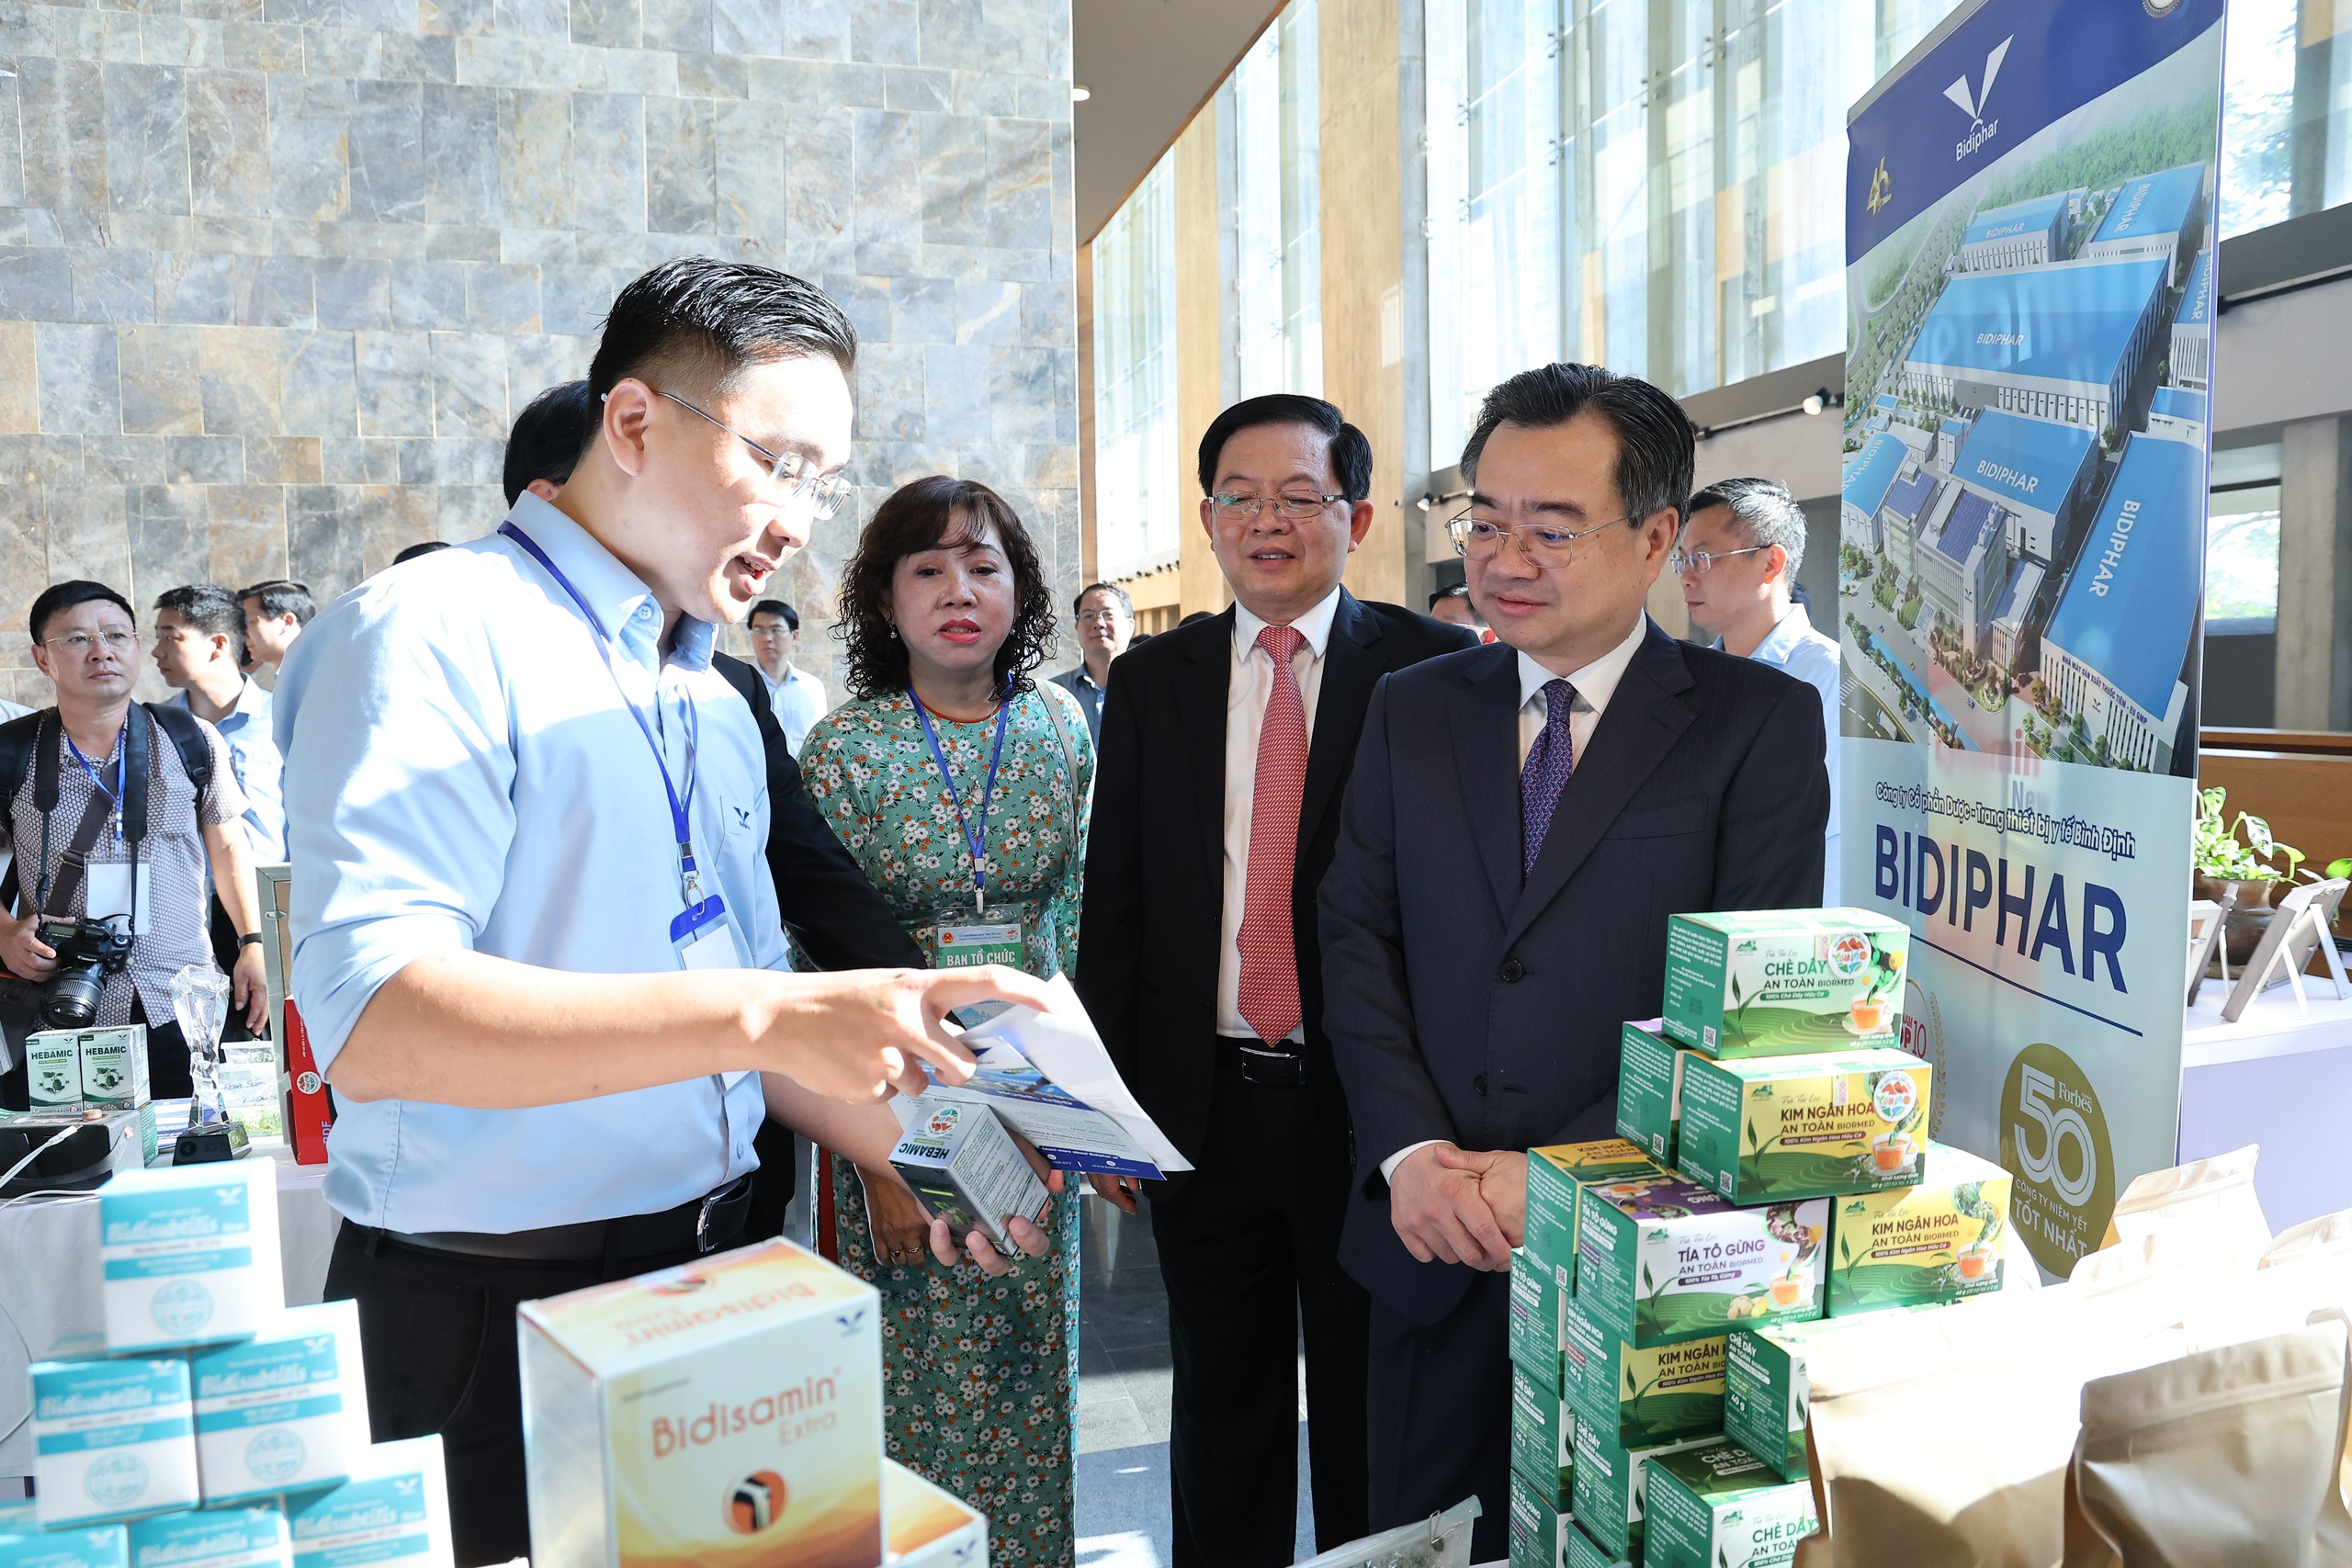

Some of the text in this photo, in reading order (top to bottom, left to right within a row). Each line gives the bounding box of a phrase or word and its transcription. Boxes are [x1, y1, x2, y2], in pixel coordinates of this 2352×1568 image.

[1956, 118, 1999, 162] Bidiphar
[2115, 184, 2151, 232] BIDIPHAR
[1985, 223, 2025, 238] BIDIPHAR
[1976, 333, 2024, 346] BIDIPHAR
[1976, 460, 2039, 493] BIDIPHAR
[2089, 500, 2141, 597] BIDIPHAR
[2062, 655, 2071, 666] NHÀ
[2072, 662, 2081, 672] MÁY
[2102, 682, 2116, 698] THUỐC
[2116, 694, 2127, 707] TIÊM
[2130, 706, 2136, 716] EU
[2137, 711, 2148, 724] GMP
[1875, 782, 1899, 808] Công
[1899, 785, 1908, 808] ty
[1907, 784, 1921, 807] Cổ
[1922, 786, 1945, 814] phần
[1945, 795, 1971, 824] Dược
[1975, 802, 2005, 833] Trang
[2007, 807, 2036, 831] thiết
[2037, 811, 2051, 843] bị
[2051, 820, 2060, 844] y
[2060, 815, 2075, 843] tế
[2074, 818, 2100, 851] Bình
[2101, 827, 2136, 862] Định
[1875, 824, 2128, 994] BIDIPHAR
[947, 948, 1015, 966] BAN TỔ CHỨC
[1765, 958, 1828, 976] CHÈ DÂY
[1764, 976, 1854, 989] AN TOÀN BIORMED
[85, 1046, 127, 1055] HEBAMIC
[1912, 1020, 1927, 1059] 10
[31, 1050, 74, 1060] HEBAMIC
[2058, 1081, 2093, 1114] Forbes
[1781, 1102, 1875, 1122] KIM NGÂN HOA
[1781, 1120, 1875, 1134] AN TOÀN BIORMED
[2014, 1063, 2097, 1207] 50
[899, 1143, 951, 1159] HEBAMIC
[2016, 1177, 2088, 1233] CÔNG TY NIÊM YẾT
[1872, 1213, 1959, 1235] KIM NGÂN HOA
[2014, 1197, 2087, 1259] TỐT NHẤT
[1871, 1230, 1959, 1248] AN TOÀN BIORMED
[1678, 1238, 1765, 1263] TÍA TÔ GỪNG
[1583, 1264, 1590, 1276] 40
[1679, 1257, 1763, 1275] AN TOÀN BIORMED
[1658, 1353, 1680, 1366] KIM
[1683, 1343, 1719, 1362] NGÂN
[1729, 1333, 1742, 1348] CHÈ
[1743, 1342, 1758, 1359] DÂY
[1658, 1367, 1675, 1378] AN
[1679, 1360, 1709, 1375] TOÀN
[1731, 1394, 1745, 1412] 40 g
[1752, 1517, 1819, 1542] CHÈ DÂY
[1752, 1546, 1769, 1557] AN
